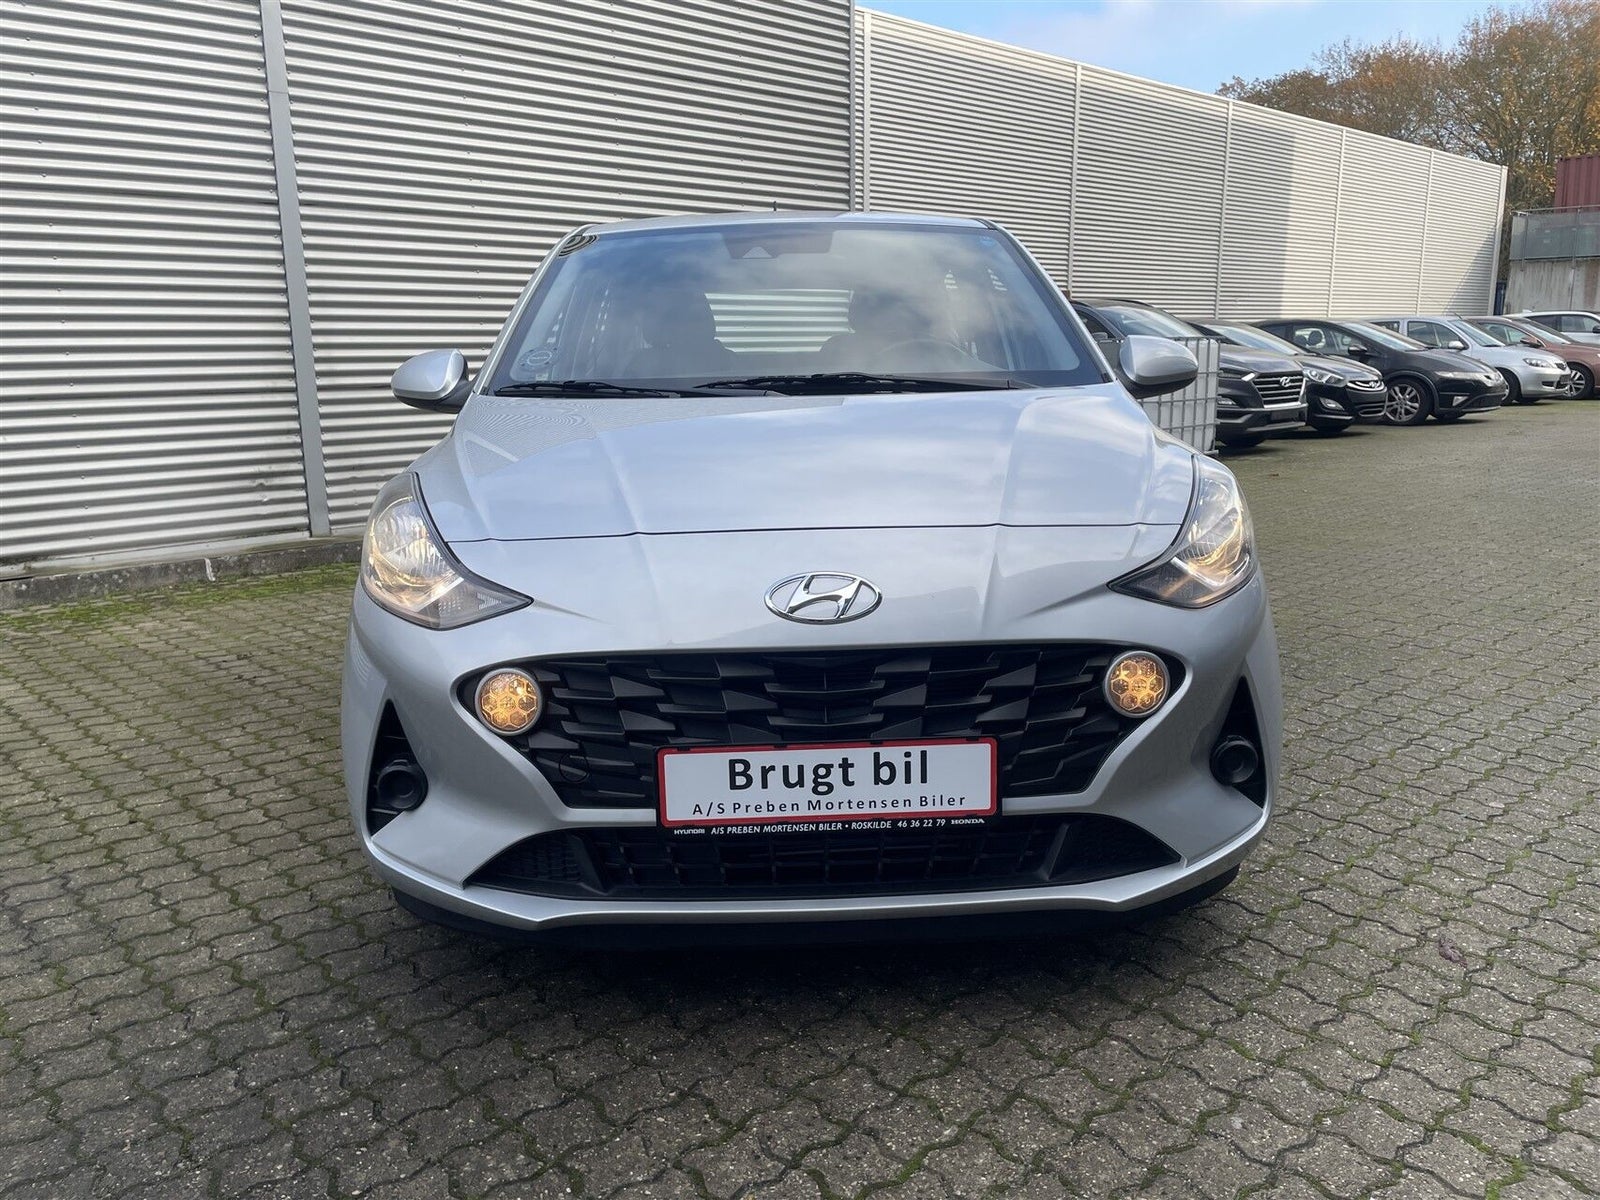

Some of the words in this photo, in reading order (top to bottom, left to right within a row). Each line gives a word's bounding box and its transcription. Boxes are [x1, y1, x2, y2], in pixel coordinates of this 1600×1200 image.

[728, 757, 855, 796] Brugt
[873, 750, 928, 787] bil
[692, 801, 725, 817] A/S
[732, 800, 800, 814] Preben
[807, 798, 912, 811] Mortensen
[919, 794, 966, 807] Biler
[710, 826, 725, 835] A/S
[726, 825, 761, 834] PREBEN
[762, 823, 816, 833] MORTENSEN
[818, 822, 843, 831] BILER
[851, 820, 892, 830] ROSKILDE
[896, 819, 908, 828] 46
[910, 819, 920, 828] 36
[922, 818, 933, 827] 22
[936, 818, 946, 827] 79
[950, 817, 985, 825] HONDA
